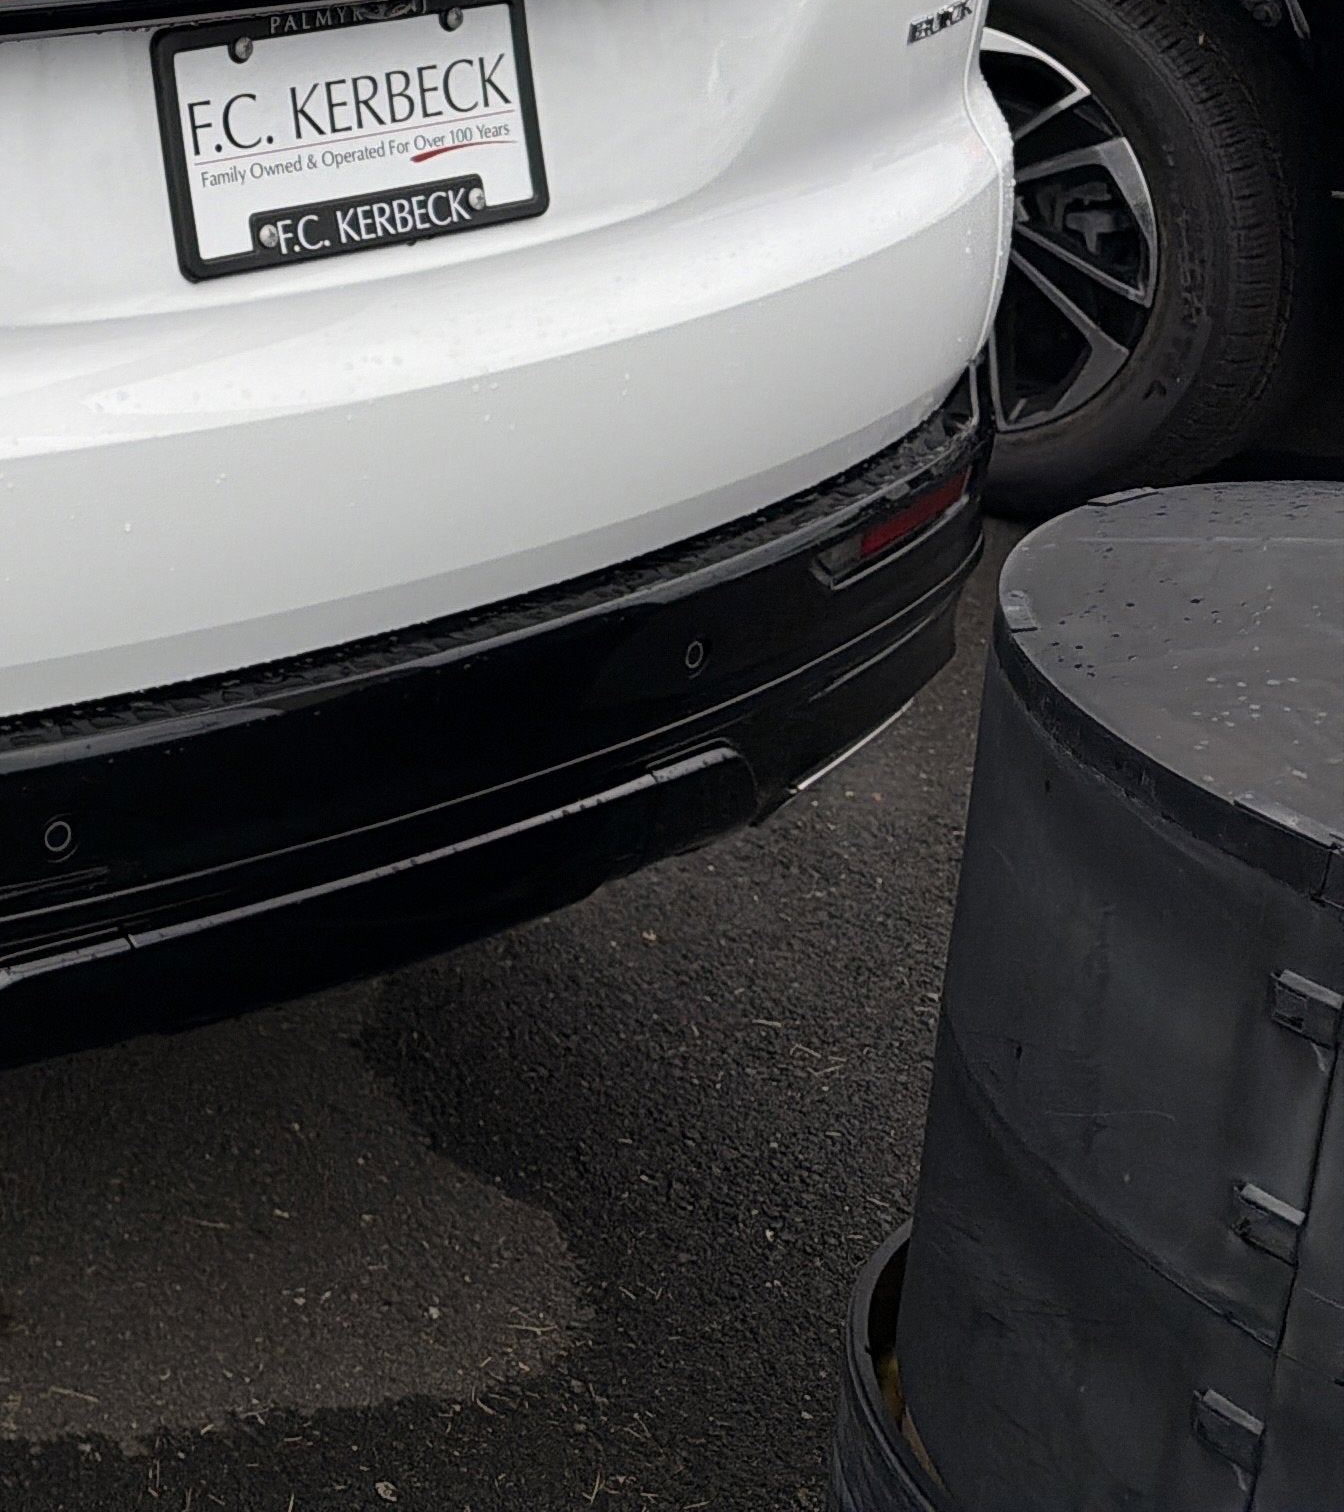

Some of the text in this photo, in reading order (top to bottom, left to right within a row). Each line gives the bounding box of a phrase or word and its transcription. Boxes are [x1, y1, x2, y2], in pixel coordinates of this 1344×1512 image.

[186, 52, 512, 157] F.C. KERBECK
[200, 121, 511, 188] Family Owned & Operated For Over 100 Years
[277, 187, 473, 255] F.C. KERBECK
